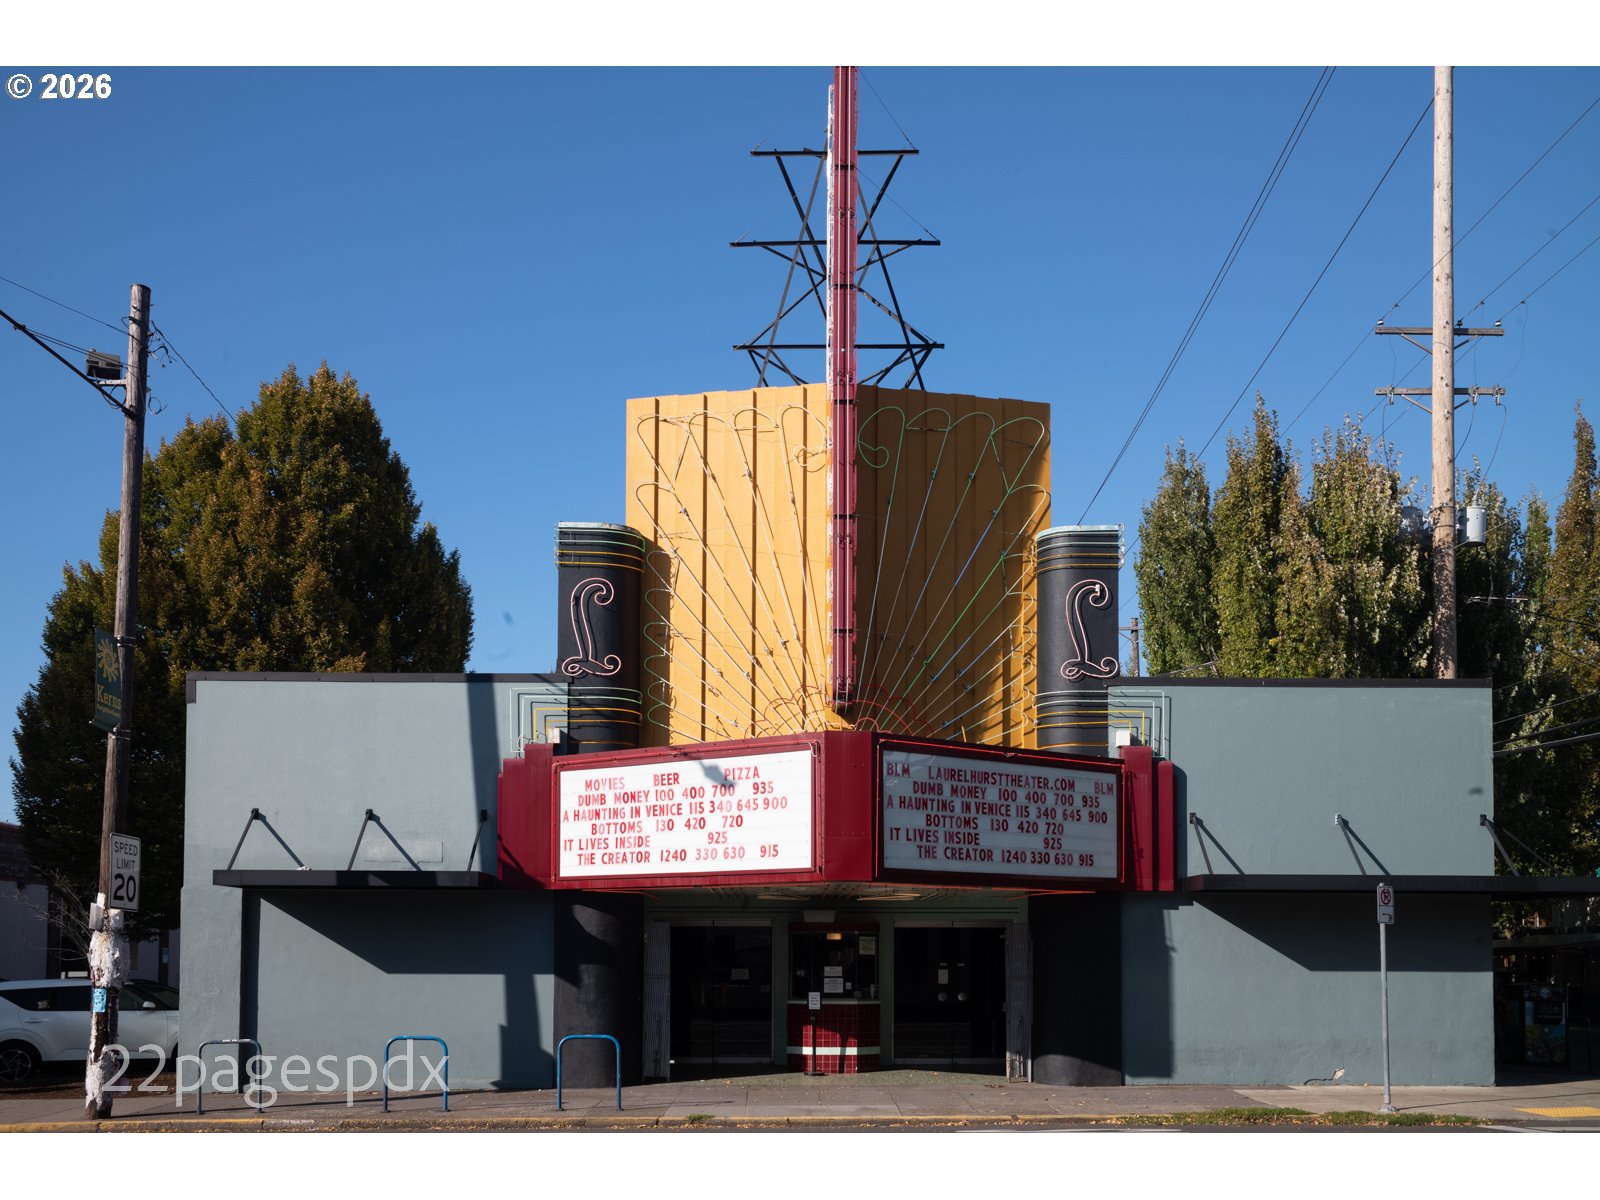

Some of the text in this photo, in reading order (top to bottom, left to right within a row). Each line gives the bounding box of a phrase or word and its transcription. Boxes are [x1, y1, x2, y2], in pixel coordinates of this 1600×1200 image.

[96, 683, 122, 710] Kerns
[585, 766, 760, 791] MOVIES BEER PIZZA
[886, 762, 1114, 795] BLM LAURELHURSTTHEATER.COM BLM
[578, 781, 774, 806] DUMB MONEY 100 400 700 935
[913, 781, 1100, 808] DUMB MONEY 100 400 700 935
[563, 796, 787, 822] A HAUNTING IN VENICE 115 340 645 900
[887, 795, 1107, 823] A HAUNTING IN VENICE 115 340 645 900
[591, 815, 743, 835] BOTTOMS 130 420 720
[926, 814, 1064, 835] BOTTOMS 130 420 720
[114, 840, 138, 857] SPEED
[564, 831, 727, 851] IT LIVES INSIDE 925
[890, 828, 1062, 850] IT LIVES INSIDE 925
[116, 858, 136, 870] LIMIT
[578, 844, 778, 866] THE CREATOR 1240 330 630 915
[917, 845, 1094, 866] THE CREATOR 1240 330 630 915
[113, 873, 136, 902] 20
